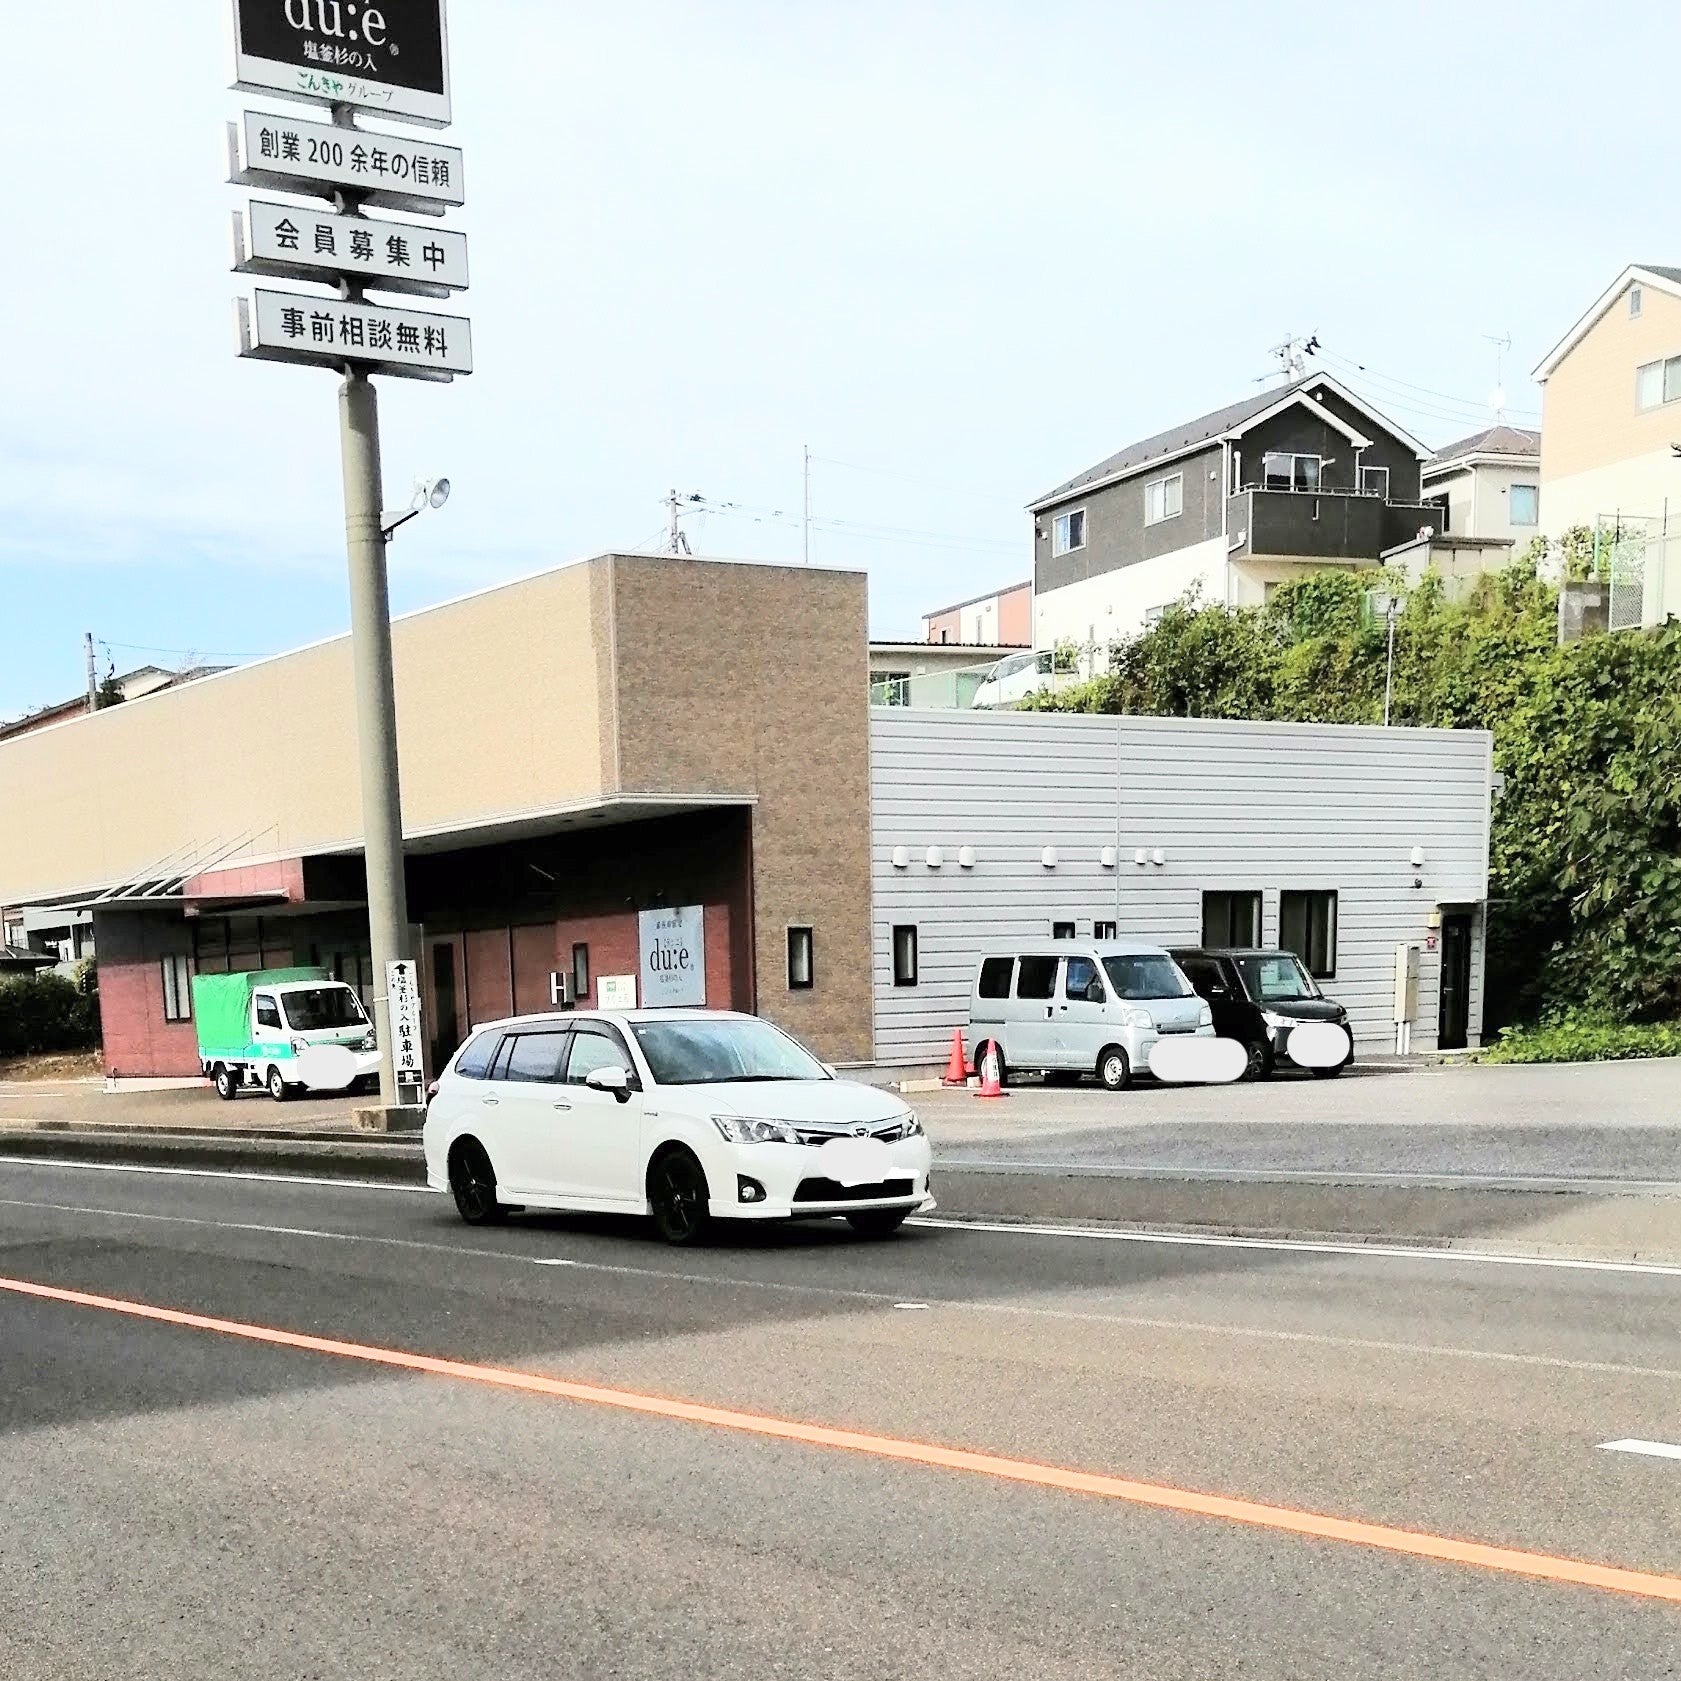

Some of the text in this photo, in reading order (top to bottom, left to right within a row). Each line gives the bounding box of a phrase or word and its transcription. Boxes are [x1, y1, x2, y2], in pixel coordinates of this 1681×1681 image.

[275, 218, 445, 271] 会員募集中
[281, 307, 448, 358] 事前相談無料
